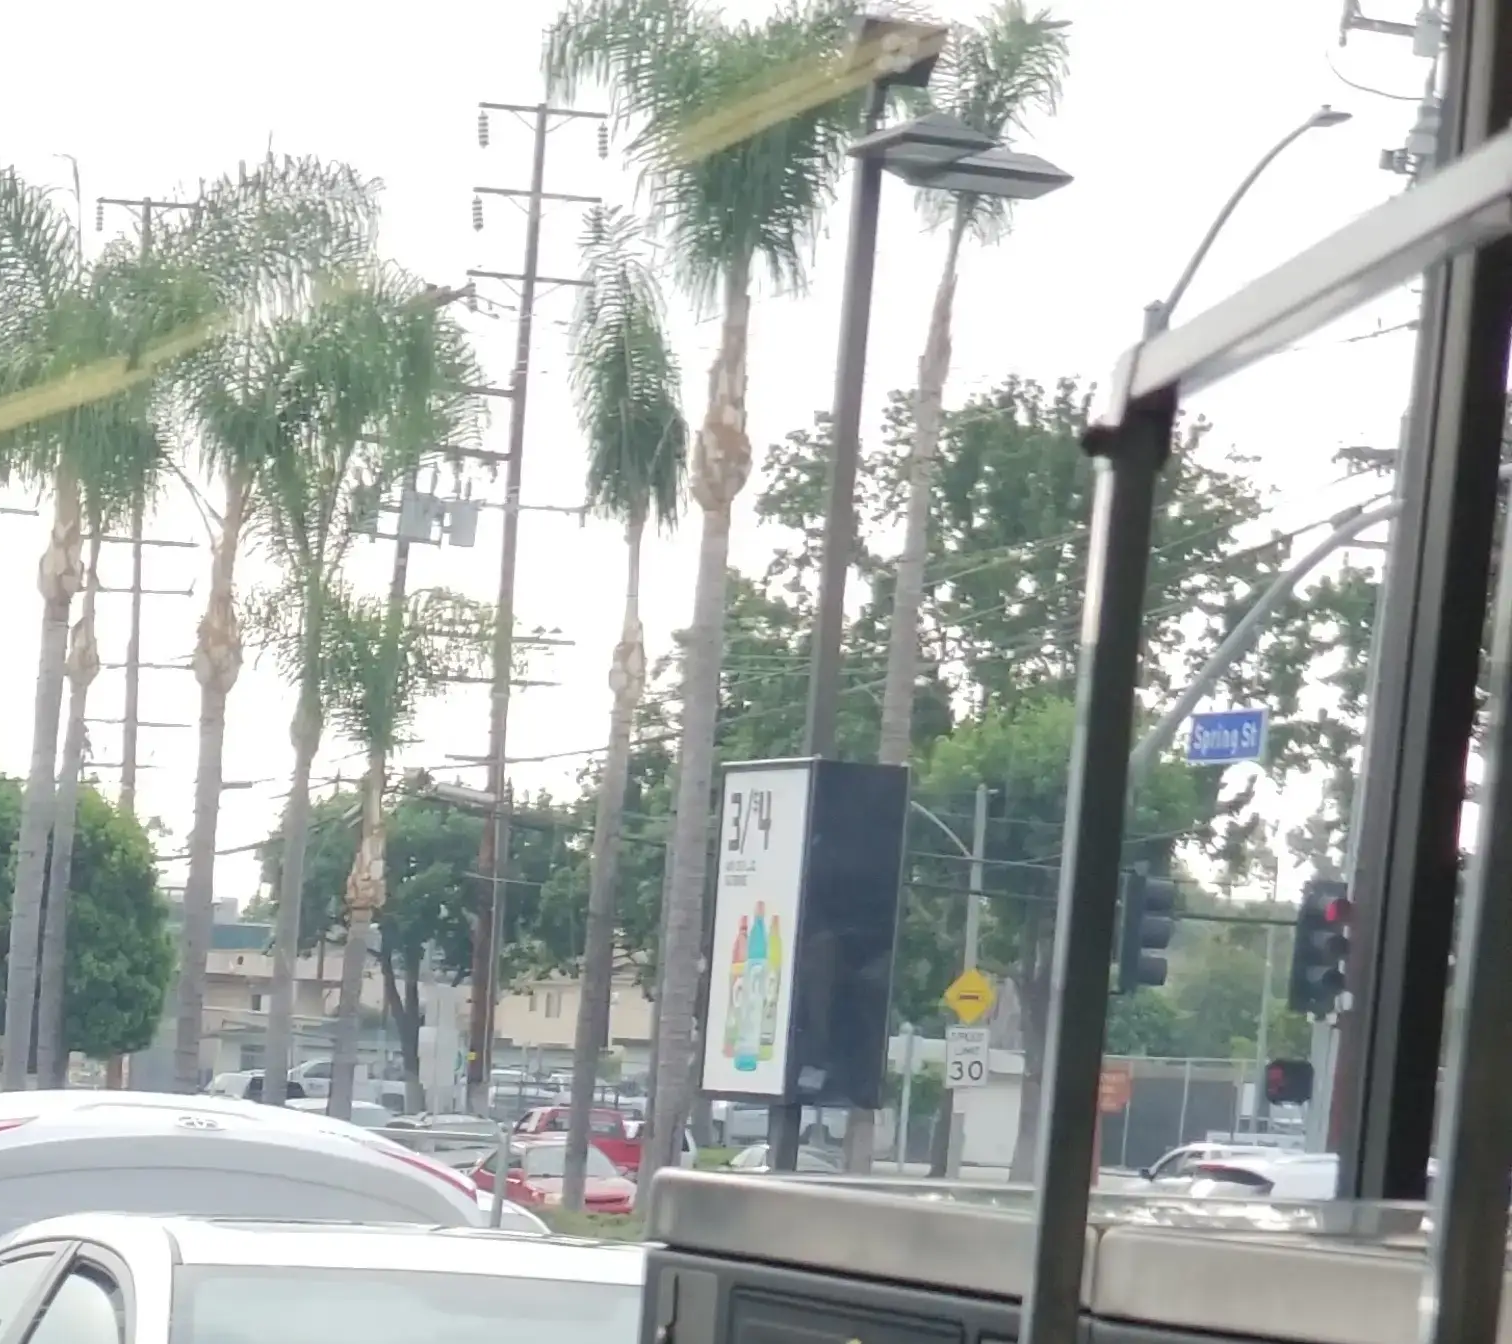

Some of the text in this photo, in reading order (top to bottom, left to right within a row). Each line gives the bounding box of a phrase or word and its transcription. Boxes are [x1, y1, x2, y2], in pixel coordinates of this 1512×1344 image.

[1193, 721, 1257, 756] Spring St
[949, 1060, 984, 1081] 30
